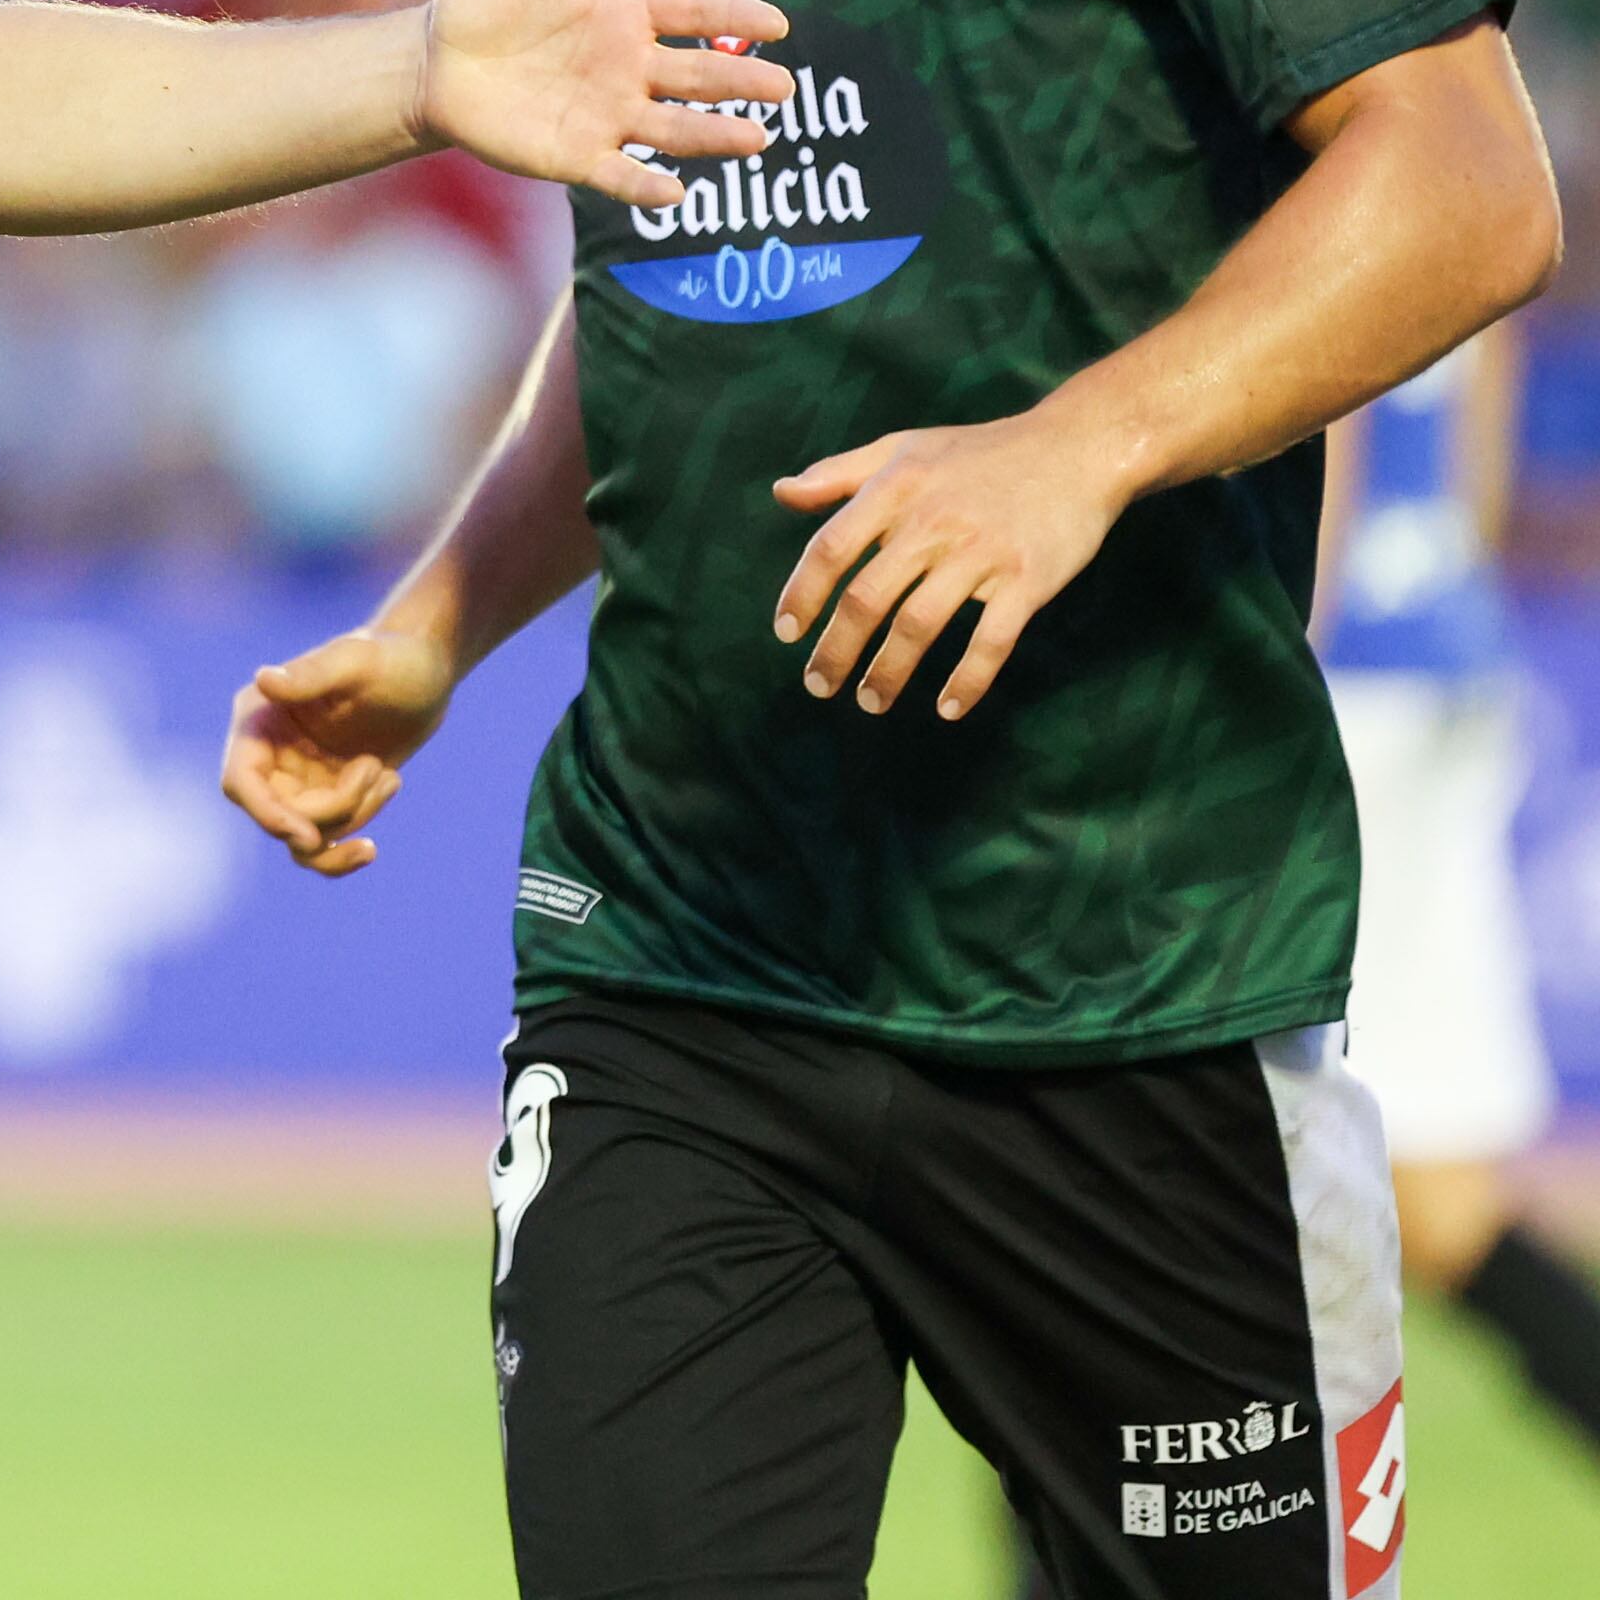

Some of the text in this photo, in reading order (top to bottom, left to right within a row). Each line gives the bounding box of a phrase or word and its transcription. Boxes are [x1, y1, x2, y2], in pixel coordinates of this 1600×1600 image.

[715, 236, 795, 309] 0,0
[1120, 1400, 1311, 1464] FERROL
[1174, 1479, 1267, 1511] XUNTA
[1174, 1487, 1316, 1535] DE GALICIA
